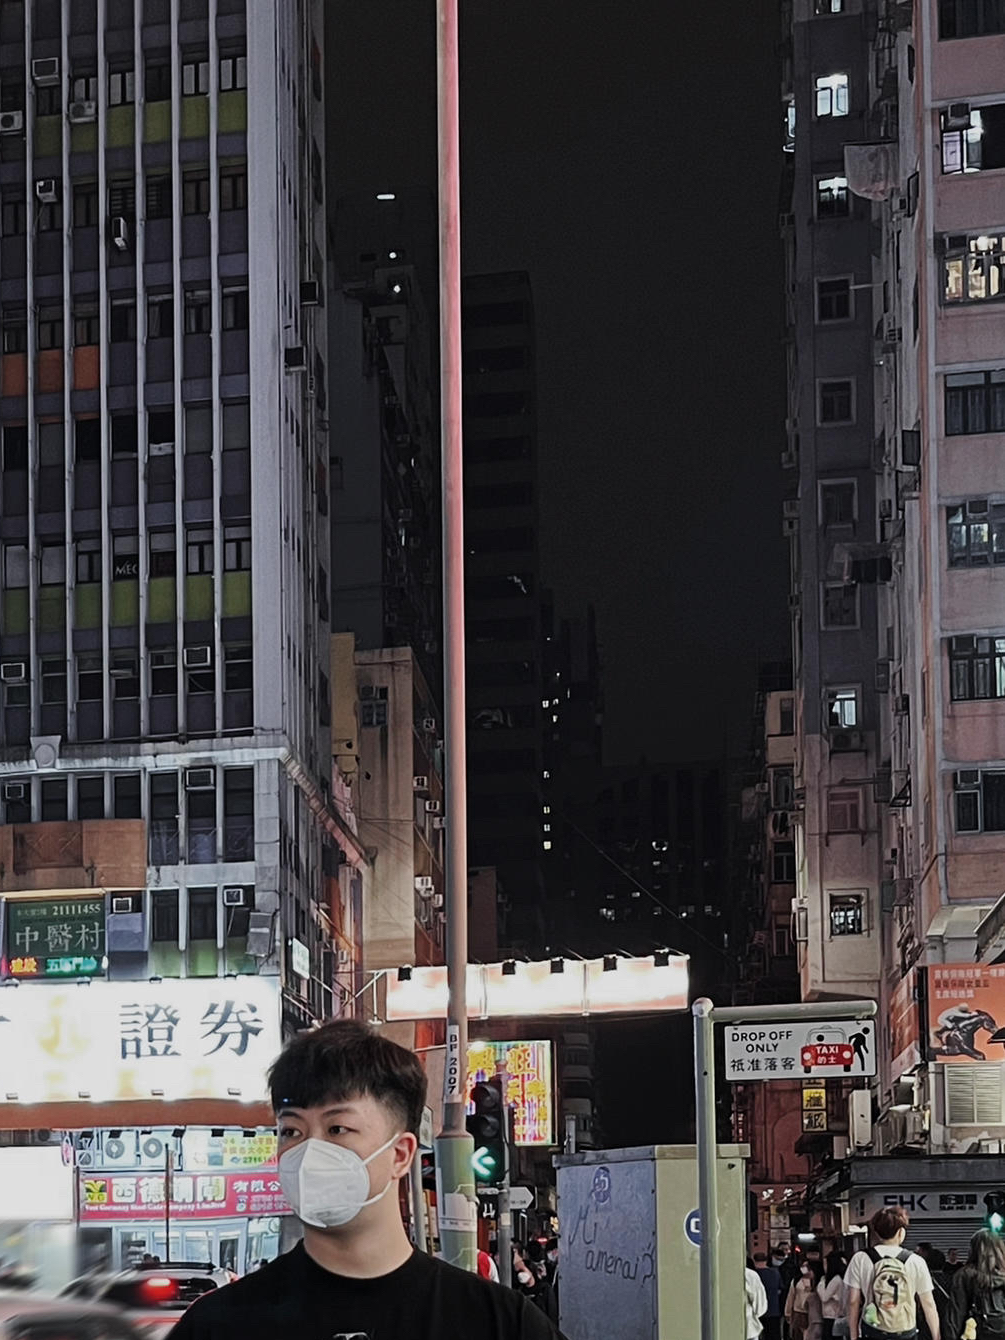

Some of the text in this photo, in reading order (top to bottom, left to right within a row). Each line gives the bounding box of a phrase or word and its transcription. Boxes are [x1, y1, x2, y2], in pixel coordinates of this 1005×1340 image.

[15, 921, 105, 953] 中醫村
[118, 999, 266, 1061] 證券
[731, 1030, 793, 1042] DROP OFF
[745, 1043, 780, 1053] ONLY
[815, 1045, 839, 1054] TAXI
[816, 1055, 837, 1064] 的士
[447, 1059, 458, 1095] 2007
